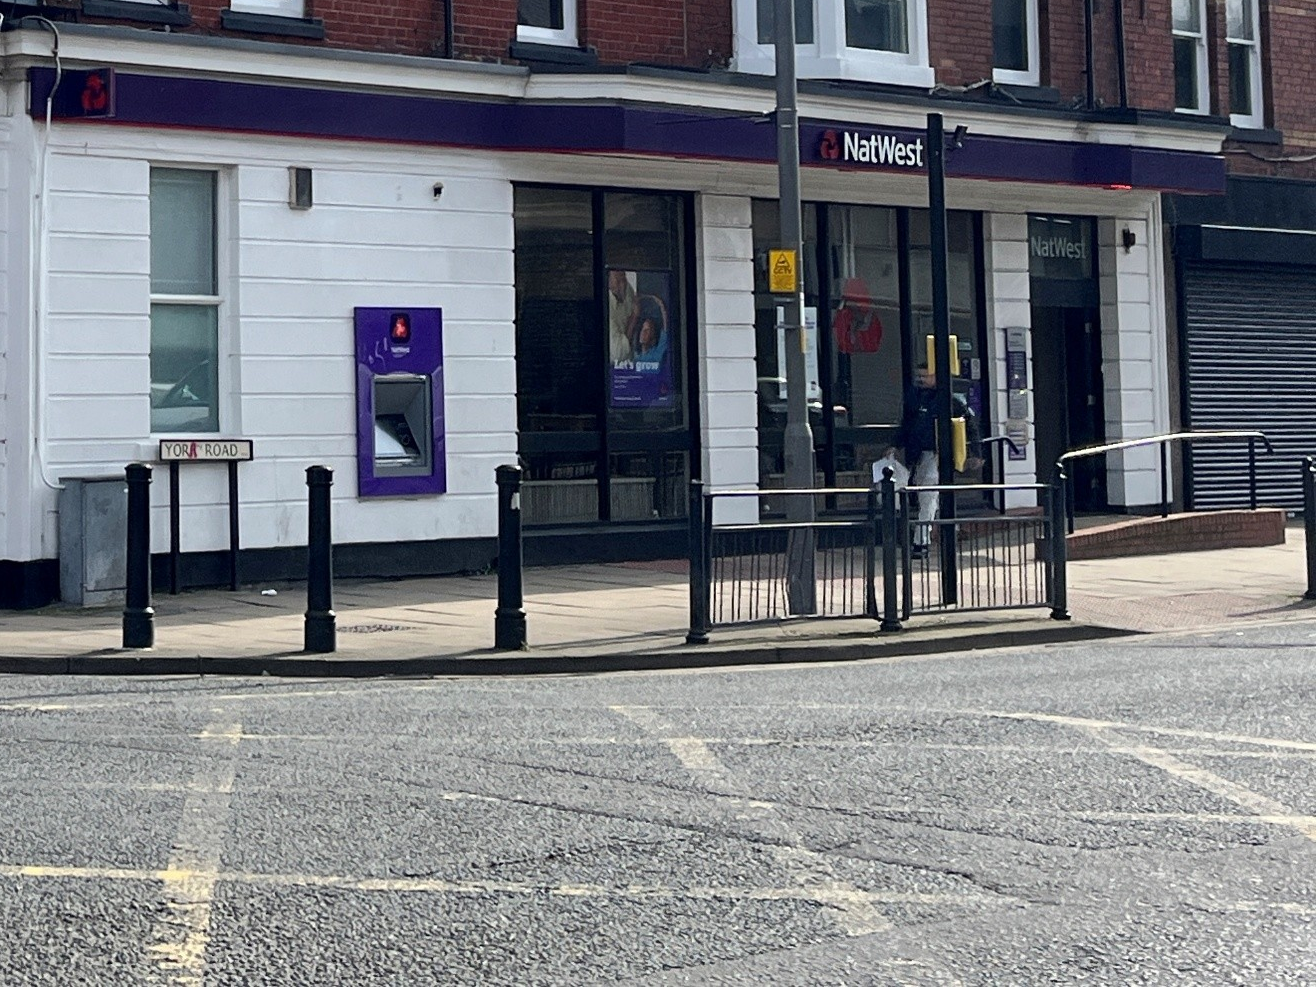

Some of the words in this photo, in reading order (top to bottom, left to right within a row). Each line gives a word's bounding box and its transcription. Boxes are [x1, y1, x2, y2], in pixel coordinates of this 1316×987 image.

[844, 131, 923, 167] NatWest
[1030, 235, 1086, 259] NatWest
[773, 266, 792, 275] CCTV
[635, 361, 660, 372] grow
[205, 443, 238, 457] ROAD
